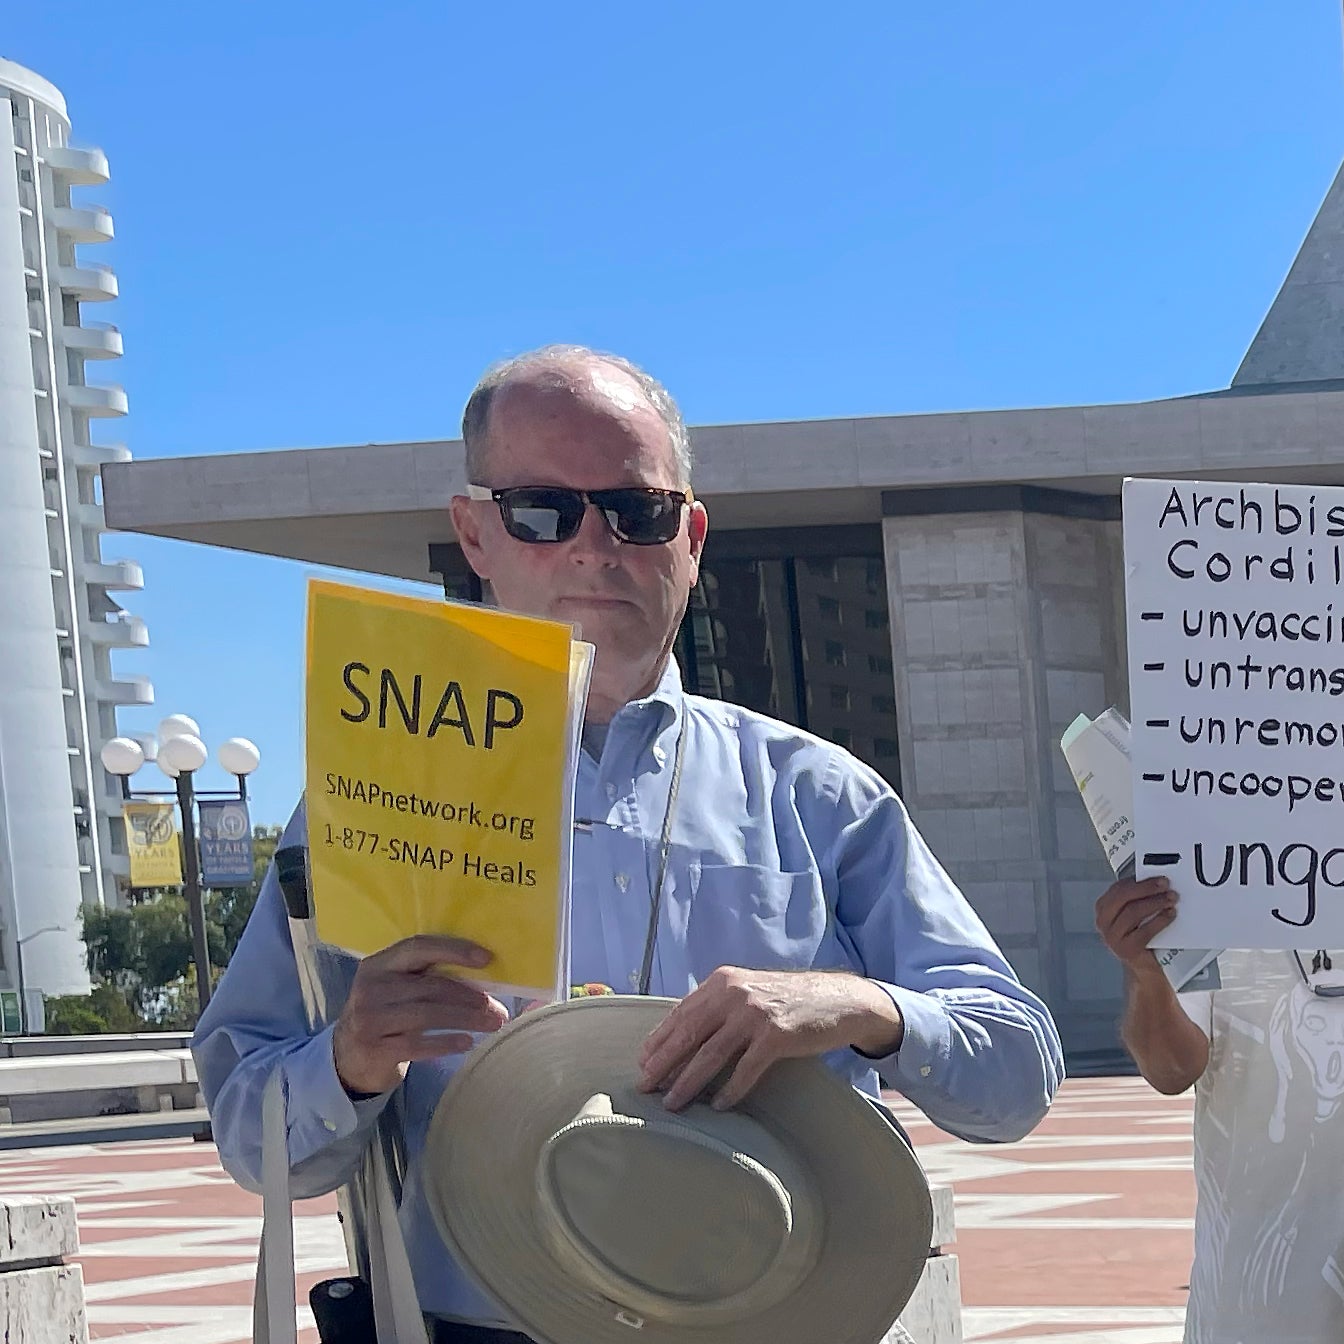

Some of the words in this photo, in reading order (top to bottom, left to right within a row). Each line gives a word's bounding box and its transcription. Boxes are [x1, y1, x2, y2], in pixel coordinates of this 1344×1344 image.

[340, 661, 524, 750] SNAP
[324, 772, 535, 843] SNAPnetwork.org
[324, 823, 454, 871] 1-877-SNAP
[462, 852, 539, 889] Heals
